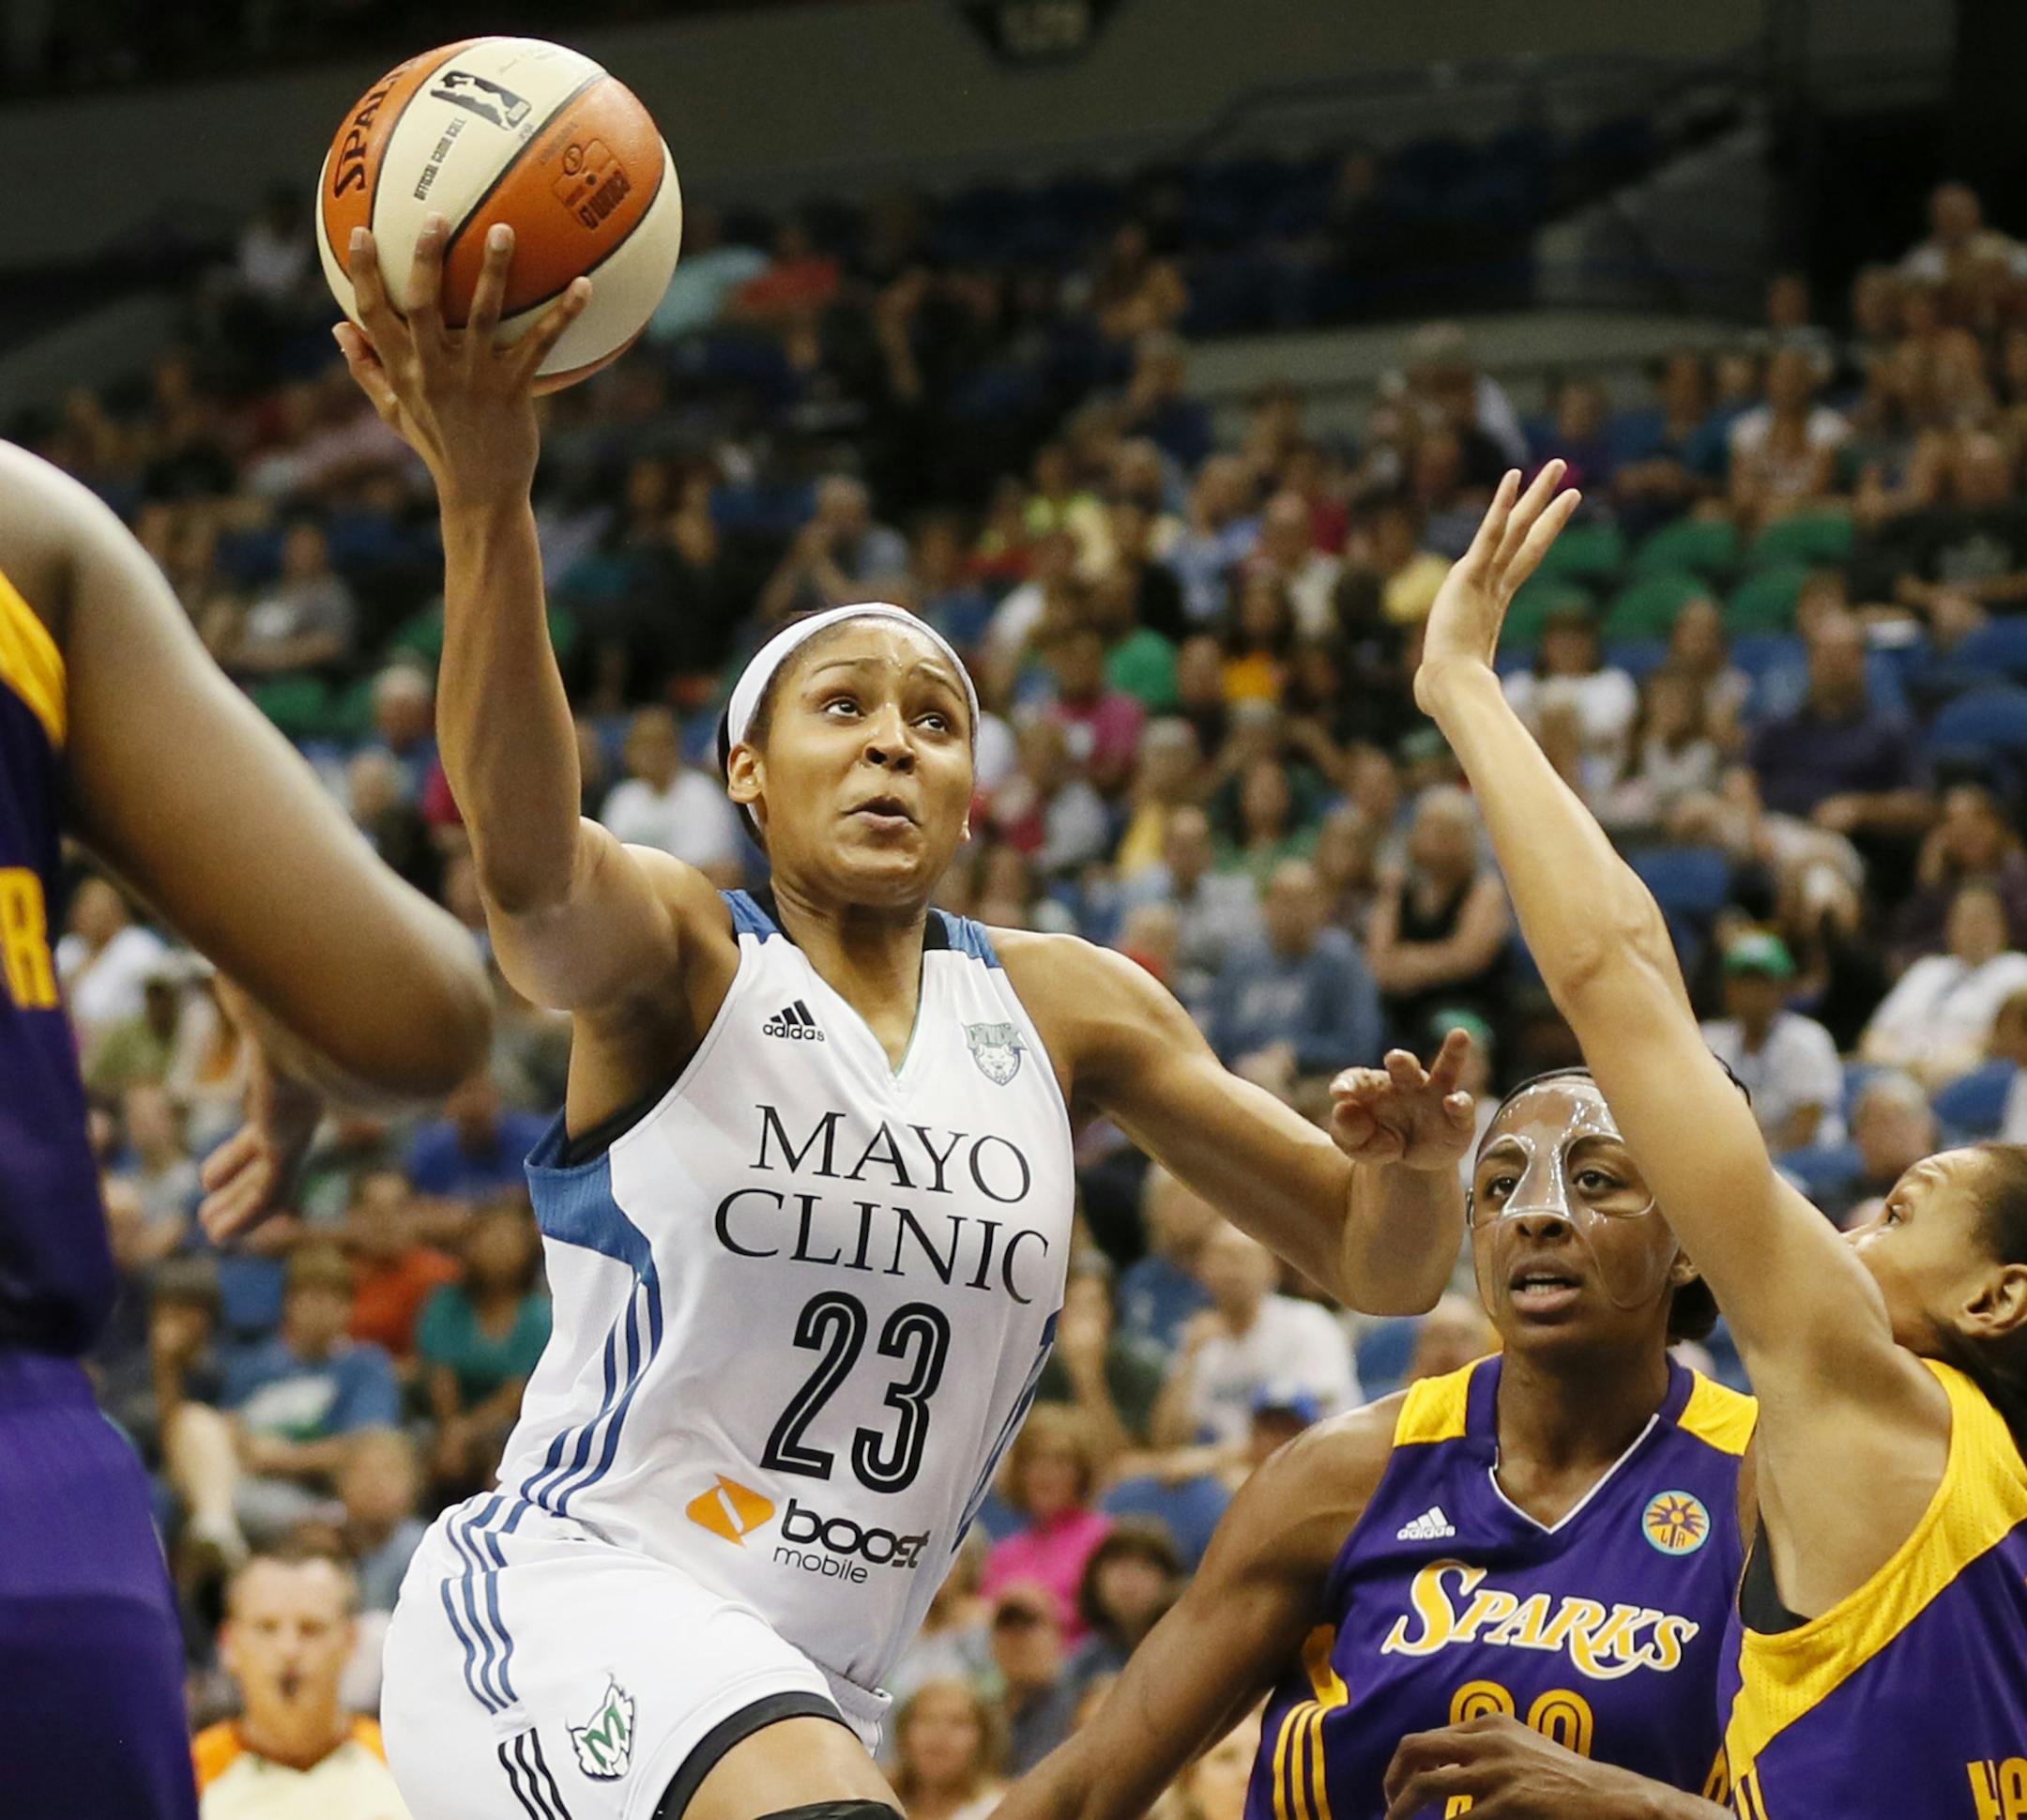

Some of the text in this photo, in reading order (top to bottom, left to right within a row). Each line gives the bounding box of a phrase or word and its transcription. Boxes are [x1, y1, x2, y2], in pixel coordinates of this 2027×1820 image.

[762, 1022, 825, 1043] adidas
[750, 1105, 1031, 1203] MAYO
[714, 1188, 1049, 1305] CLINIC
[759, 1291, 951, 1493] 23
[773, 1546, 868, 1583] mobile
[781, 1498, 931, 1568] boost
[1381, 1558, 1699, 1680] SPARKS
